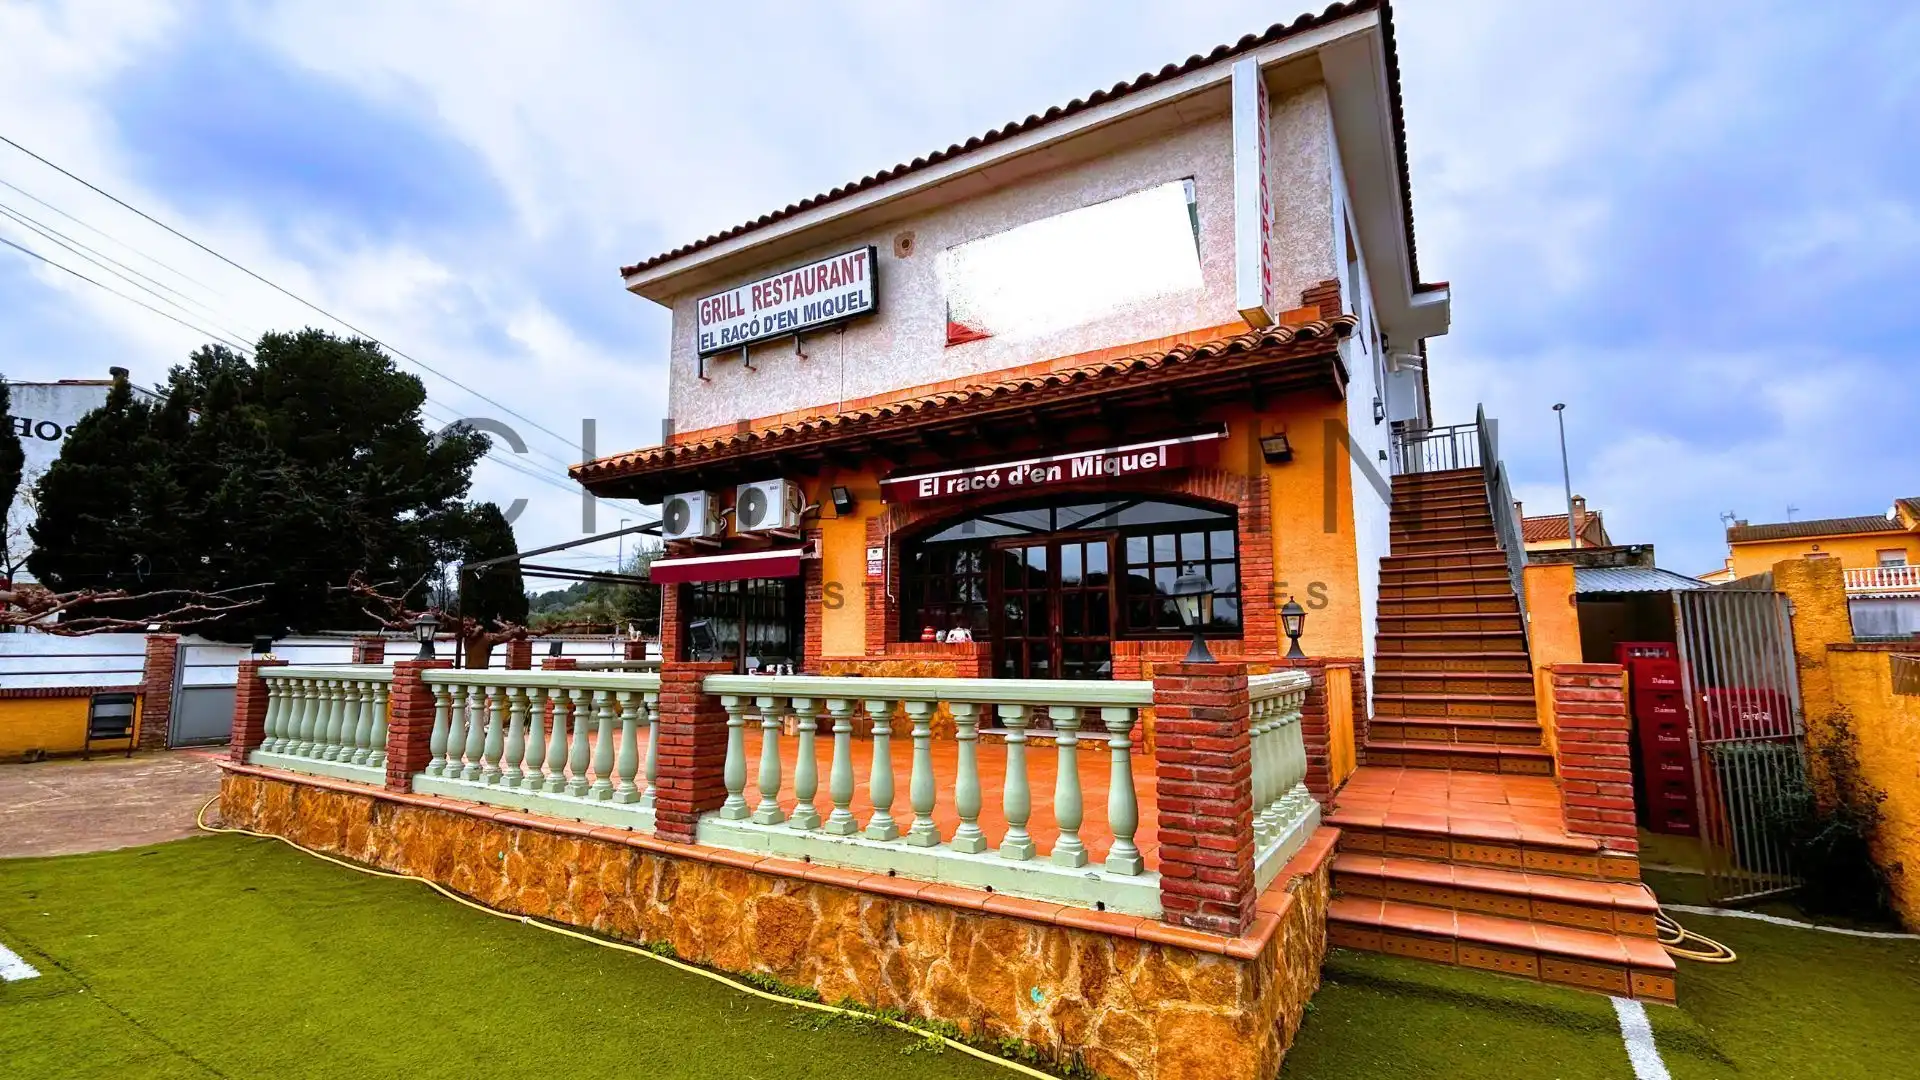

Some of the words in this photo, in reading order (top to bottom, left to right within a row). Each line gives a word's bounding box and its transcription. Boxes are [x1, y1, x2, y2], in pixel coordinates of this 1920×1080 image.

[1259, 80, 1271, 305] RESTAURANT
[700, 291, 745, 327] GRILL
[751, 251, 866, 312] RESTAURANT
[701, 332, 718, 350] EL
[721, 313, 760, 345] RACÓ
[763, 308, 798, 333] D'EN
[803, 289, 869, 323] MIQUEL
[918, 478, 939, 497] El
[946, 469, 1000, 493] racó
[1071, 445, 1167, 478] Miquel
